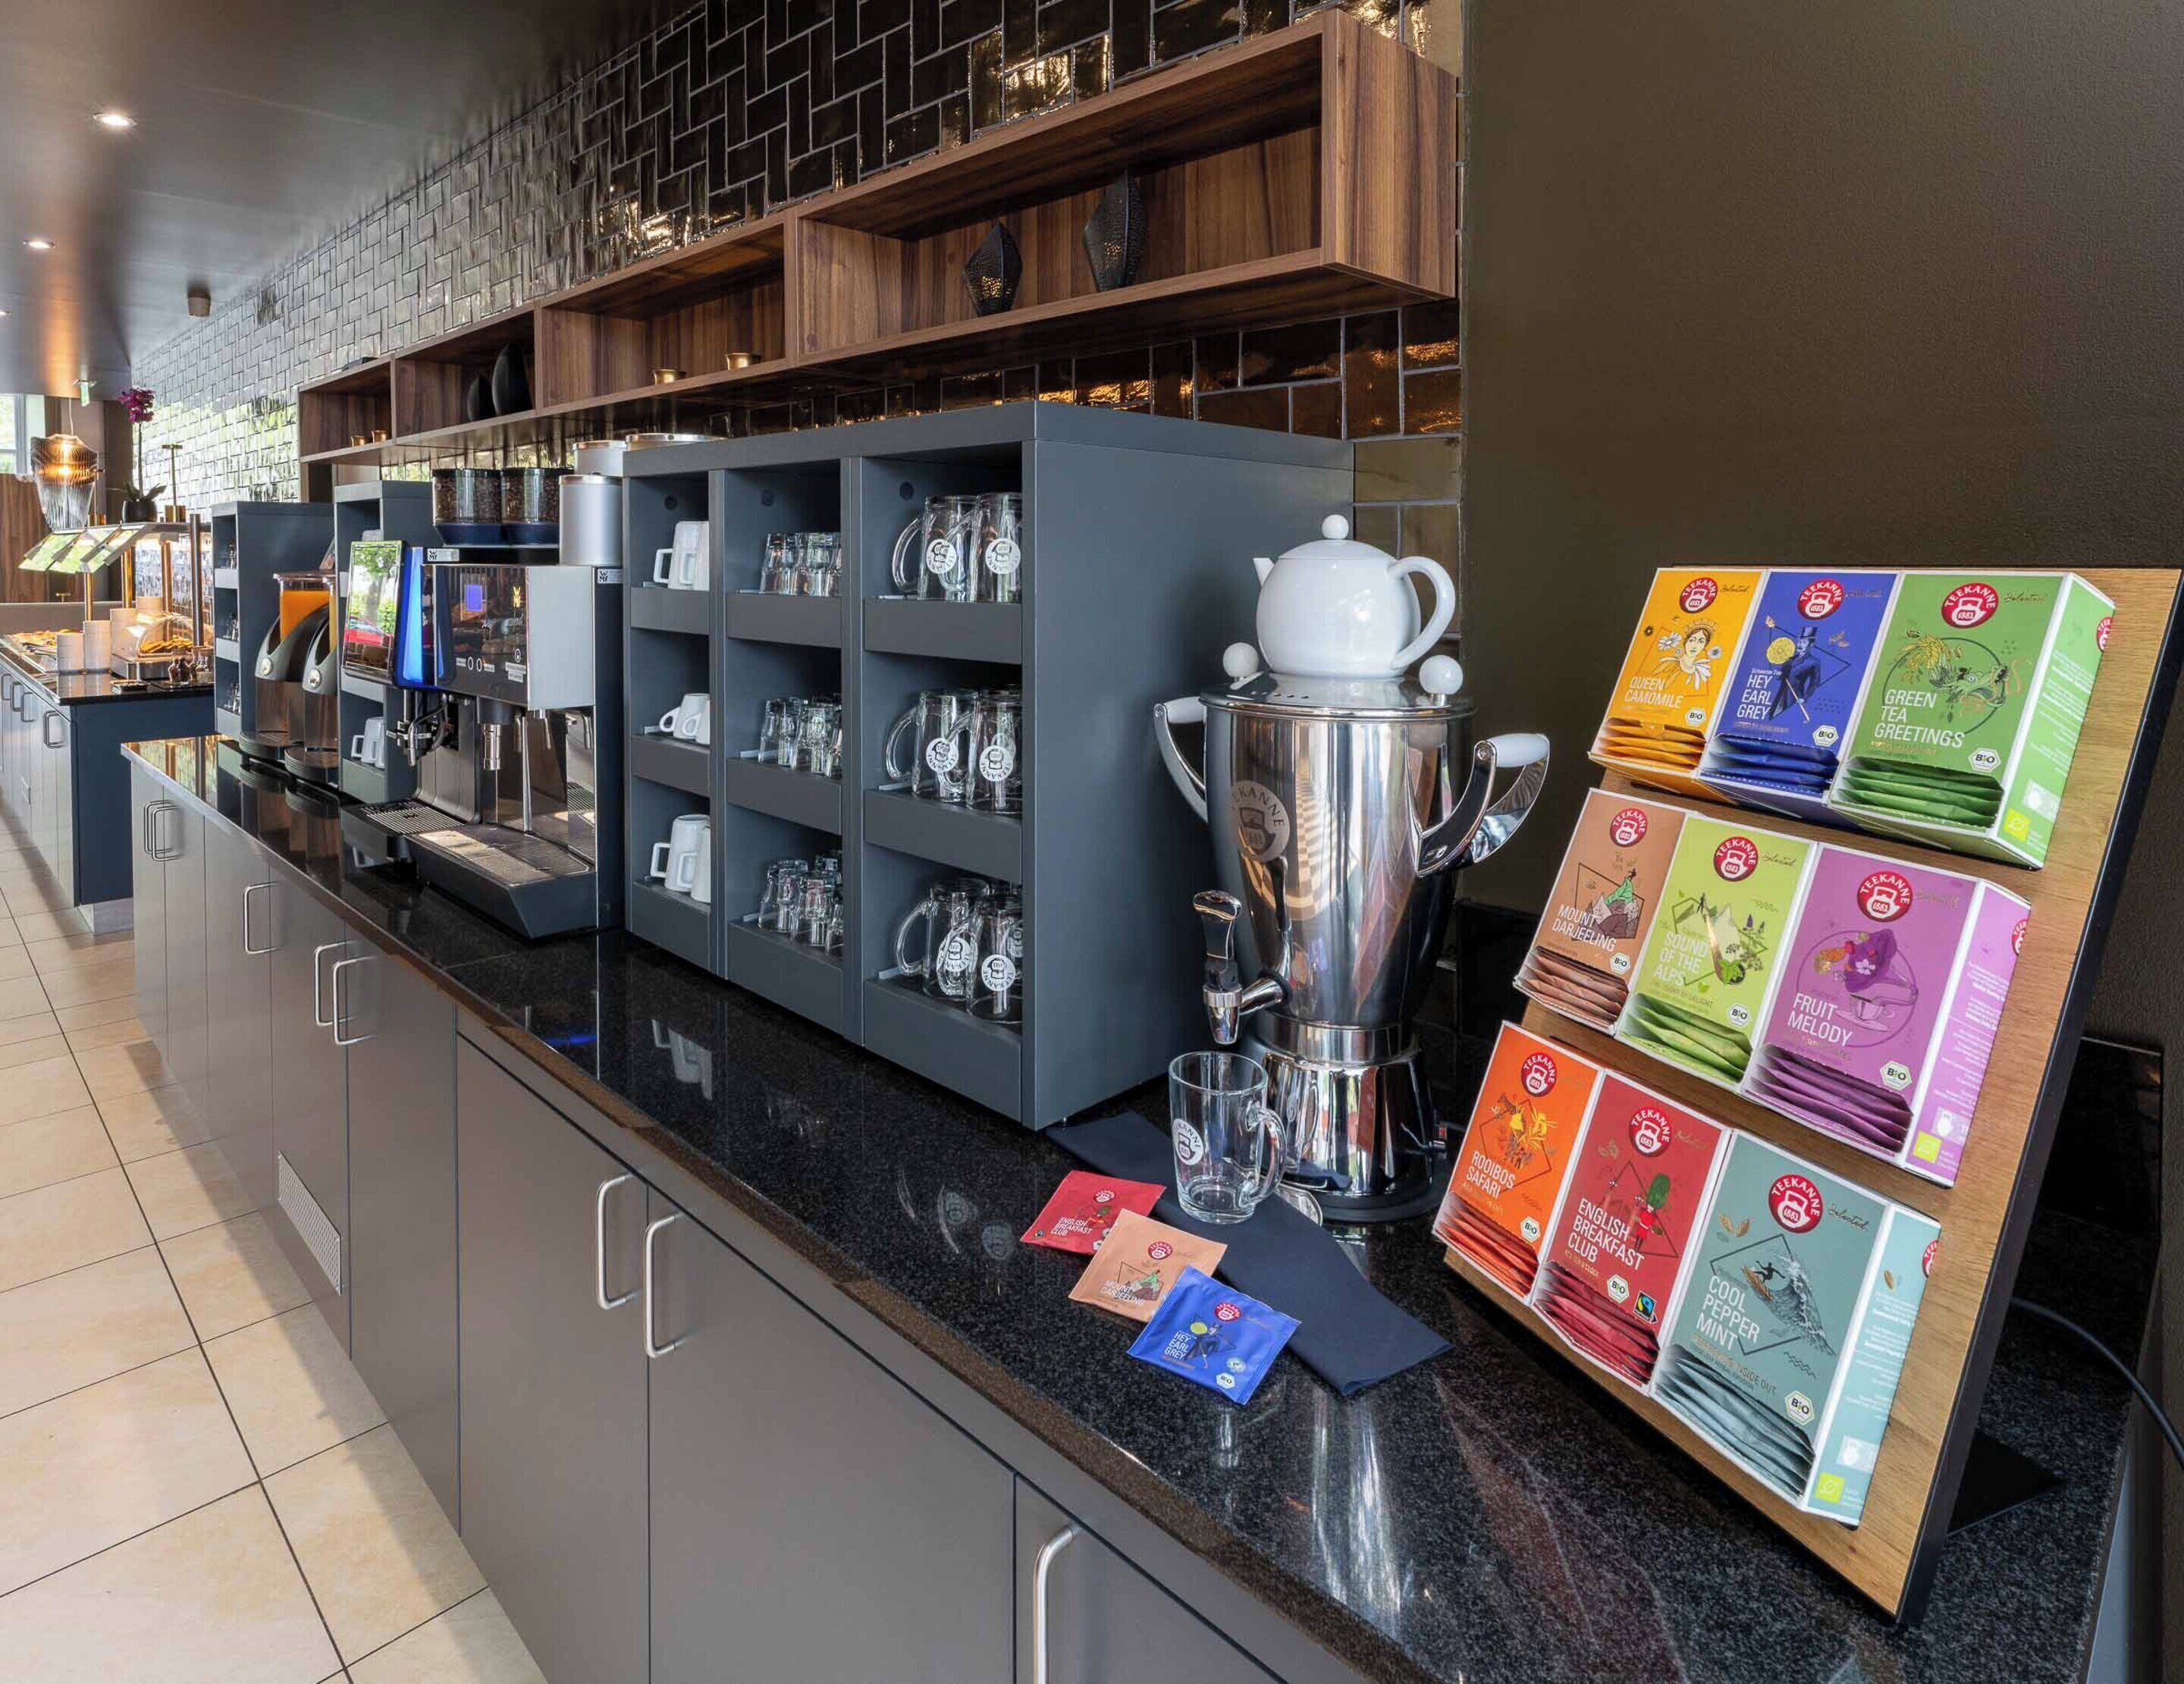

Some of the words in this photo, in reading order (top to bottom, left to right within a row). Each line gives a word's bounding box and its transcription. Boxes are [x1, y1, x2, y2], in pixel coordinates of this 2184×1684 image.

[1682, 579, 1715, 597] TEEKANNE
[1800, 582, 1842, 602] TEEKANNE
[1944, 585, 1996, 609] TEEKANNE
[1630, 676, 1665, 691] QUEEN
[1746, 675, 1772, 688] HEY
[1624, 689, 1684, 708] CAMOMILE
[1742, 689, 1772, 704] EARL
[1884, 689, 1937, 708] GREEN
[1737, 704, 1771, 720] GREY
[1881, 706, 1907, 723] TEA
[1874, 723, 1965, 748] GREETINGS
[1613, 810, 1646, 833] TEEKANNE
[1716, 839, 1757, 866] TEEKANNE
[1860, 873, 1909, 905] TEEKANNE
[1558, 904, 1596, 927] MOUNT
[1552, 919, 1617, 952] DARJEELING
[1665, 931, 1707, 958] SOUND
[1659, 948, 1677, 963] OF
[1677, 952, 1702, 974] THE
[1652, 964, 1685, 986] ALPS
[1793, 993, 1837, 1021] FRUIT
[1787, 1011, 1853, 1046] MELODY
[1523, 1055, 1555, 1083] TEEKANNE
[1631, 1109, 1669, 1143] TEEKANNE
[1472, 1150, 1515, 1189] ROOIBOS
[1466, 1166, 1501, 1199] SAFARI
[1771, 1178, 1821, 1216] TEEKANNE
[1055, 1223, 1093, 1234] BREAKFAST
[1059, 1217, 1088, 1226] ENGLISH
[1578, 1198, 1630, 1241] ENGLISH
[1050, 1228, 1068, 1237] CLUB
[1573, 1216, 1645, 1271] BREAKFAST
[1567, 1233, 1599, 1262] CLUB
[1100, 1287, 1145, 1306] DARJEELING
[1104, 1280, 1135, 1294] MOUNT
[1710, 1276, 1746, 1312] COOL
[1703, 1294, 1759, 1343] PEPPER
[1174, 1332, 1191, 1342] HEY
[1696, 1312, 1737, 1350] MINT
[1164, 1348, 1185, 1359] GREY
[1169, 1341, 1188, 1352] EARL
